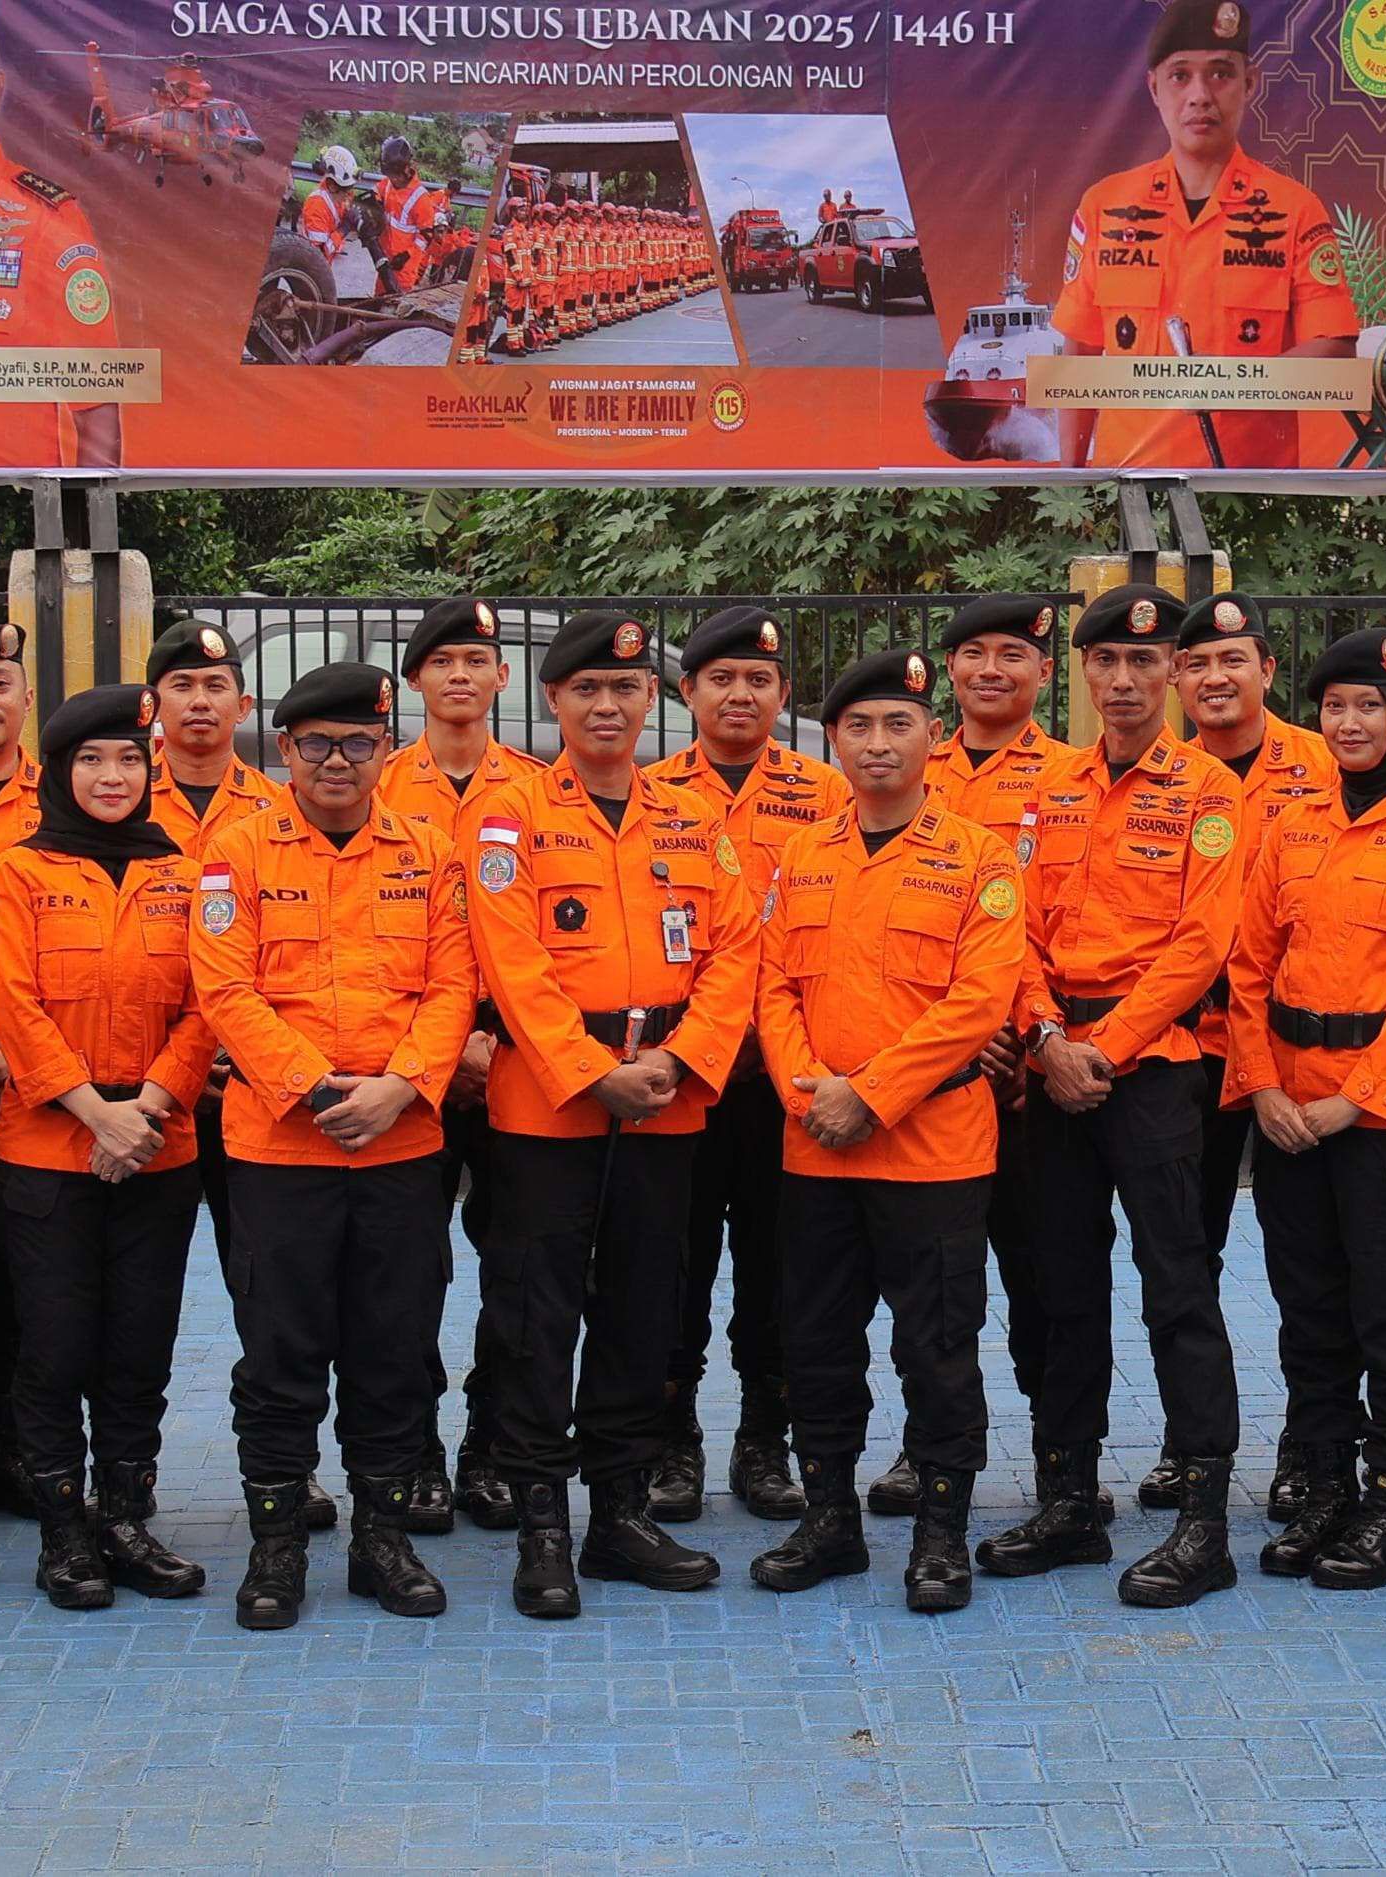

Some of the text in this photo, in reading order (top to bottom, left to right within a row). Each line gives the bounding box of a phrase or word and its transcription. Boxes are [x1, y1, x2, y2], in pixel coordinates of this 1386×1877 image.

[171, 1, 1015, 49] SIAGA SAR KHUSUS LEBARAN 2025 / 1446 H
[329, 59, 864, 89] KANTOR PENCARIAN DAN PEROLONGAN PALU
[1098, 248, 1160, 267] RIZAL
[1223, 249, 1286, 268] BASARNAS
[100, 363, 145, 375] CHRMP
[1132, 363, 1270, 380] MUH.RIZAL, S.H.
[26, 377, 124, 388] PERTOLONGAN
[549, 379, 696, 391] AVIGNAM JAGAT SAMAGRAM
[1045, 388, 1354, 401] KEPALA KANTOR PENCARIAN DAN PERTOLONGAN PALU
[426, 395, 527, 414] BerAKHLAK
[549, 395, 697, 422] WE ARE FAMILY
[717, 397, 740, 417] 115
[557, 428, 612, 438] PROFESIONAL
[618, 428, 653, 438] MODERN
[660, 428, 688, 438] TERUJI
[996, 781, 1034, 791] BASAR
[756, 802, 818, 820] BASARNAS
[1125, 817, 1186, 836] BASARNAS
[534, 834, 595, 851] M. RIZAL
[653, 837, 708, 852] BASARNAS
[902, 877, 963, 898] BASARNAS
[37, 894, 90, 910] FERA
[257, 889, 309, 905] ADI
